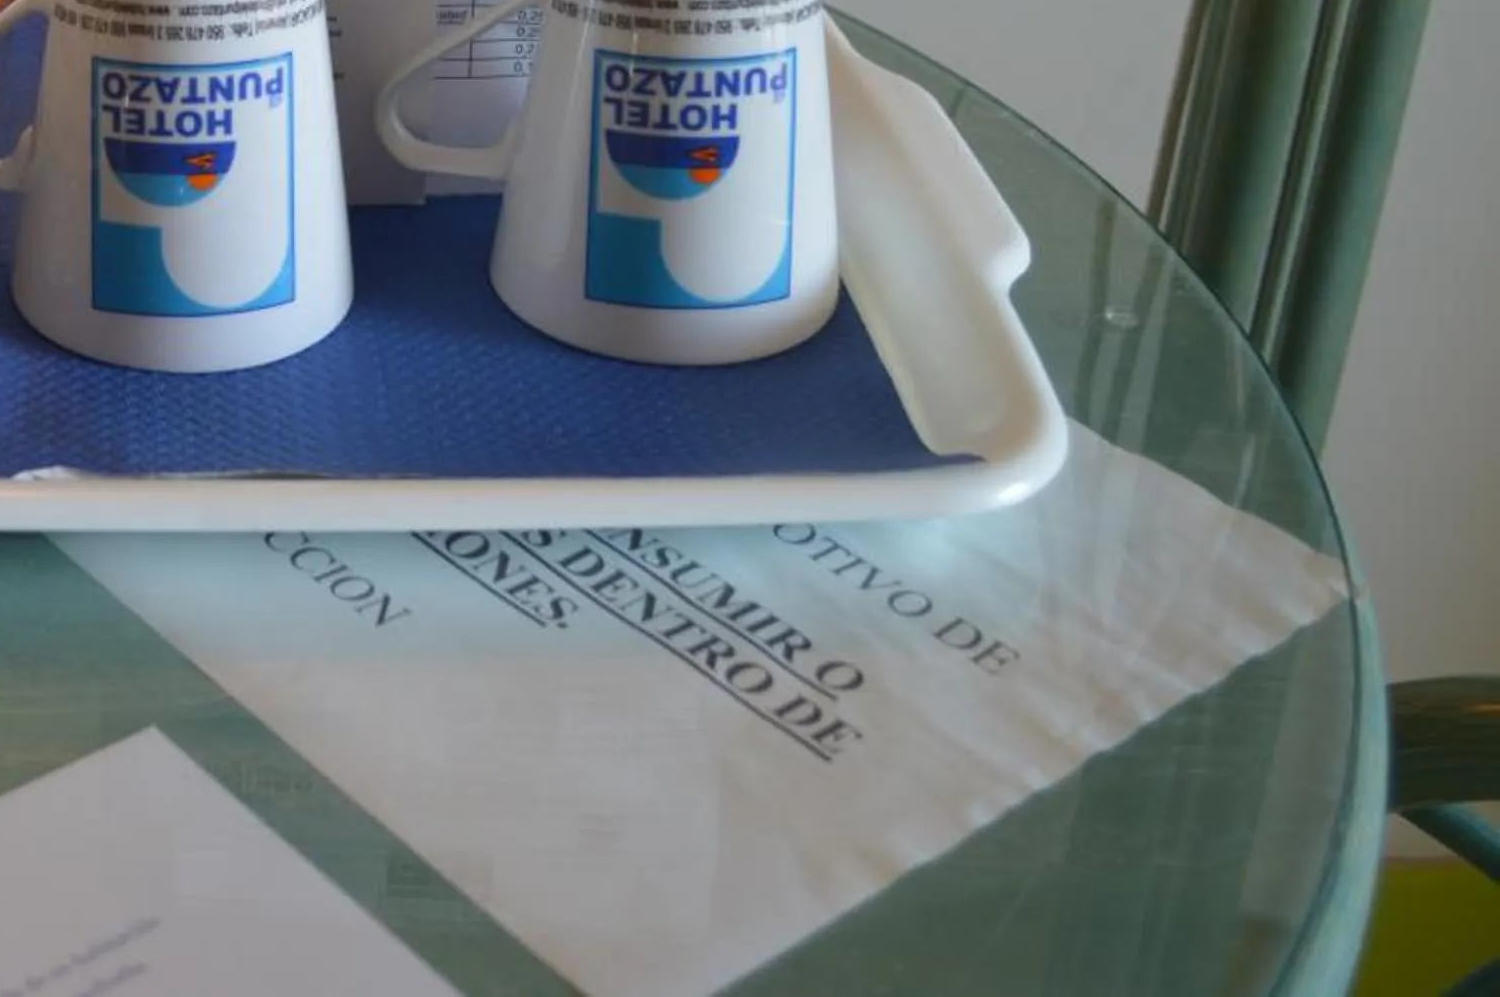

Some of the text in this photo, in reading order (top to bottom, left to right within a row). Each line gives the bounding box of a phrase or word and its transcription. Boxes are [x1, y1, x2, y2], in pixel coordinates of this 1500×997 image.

[103, 66, 284, 104] PUNTAZO
[605, 63, 788, 98] PUNTAZO
[103, 105, 233, 136] HOTEL
[604, 97, 737, 131] HOTEL
[430, 530, 580, 630] ONES.
[558, 545, 775, 696] DENTRO
[771, 695, 865, 756] DE
[931, 615, 1022, 677] DE
[813, 659, 865, 693] O
